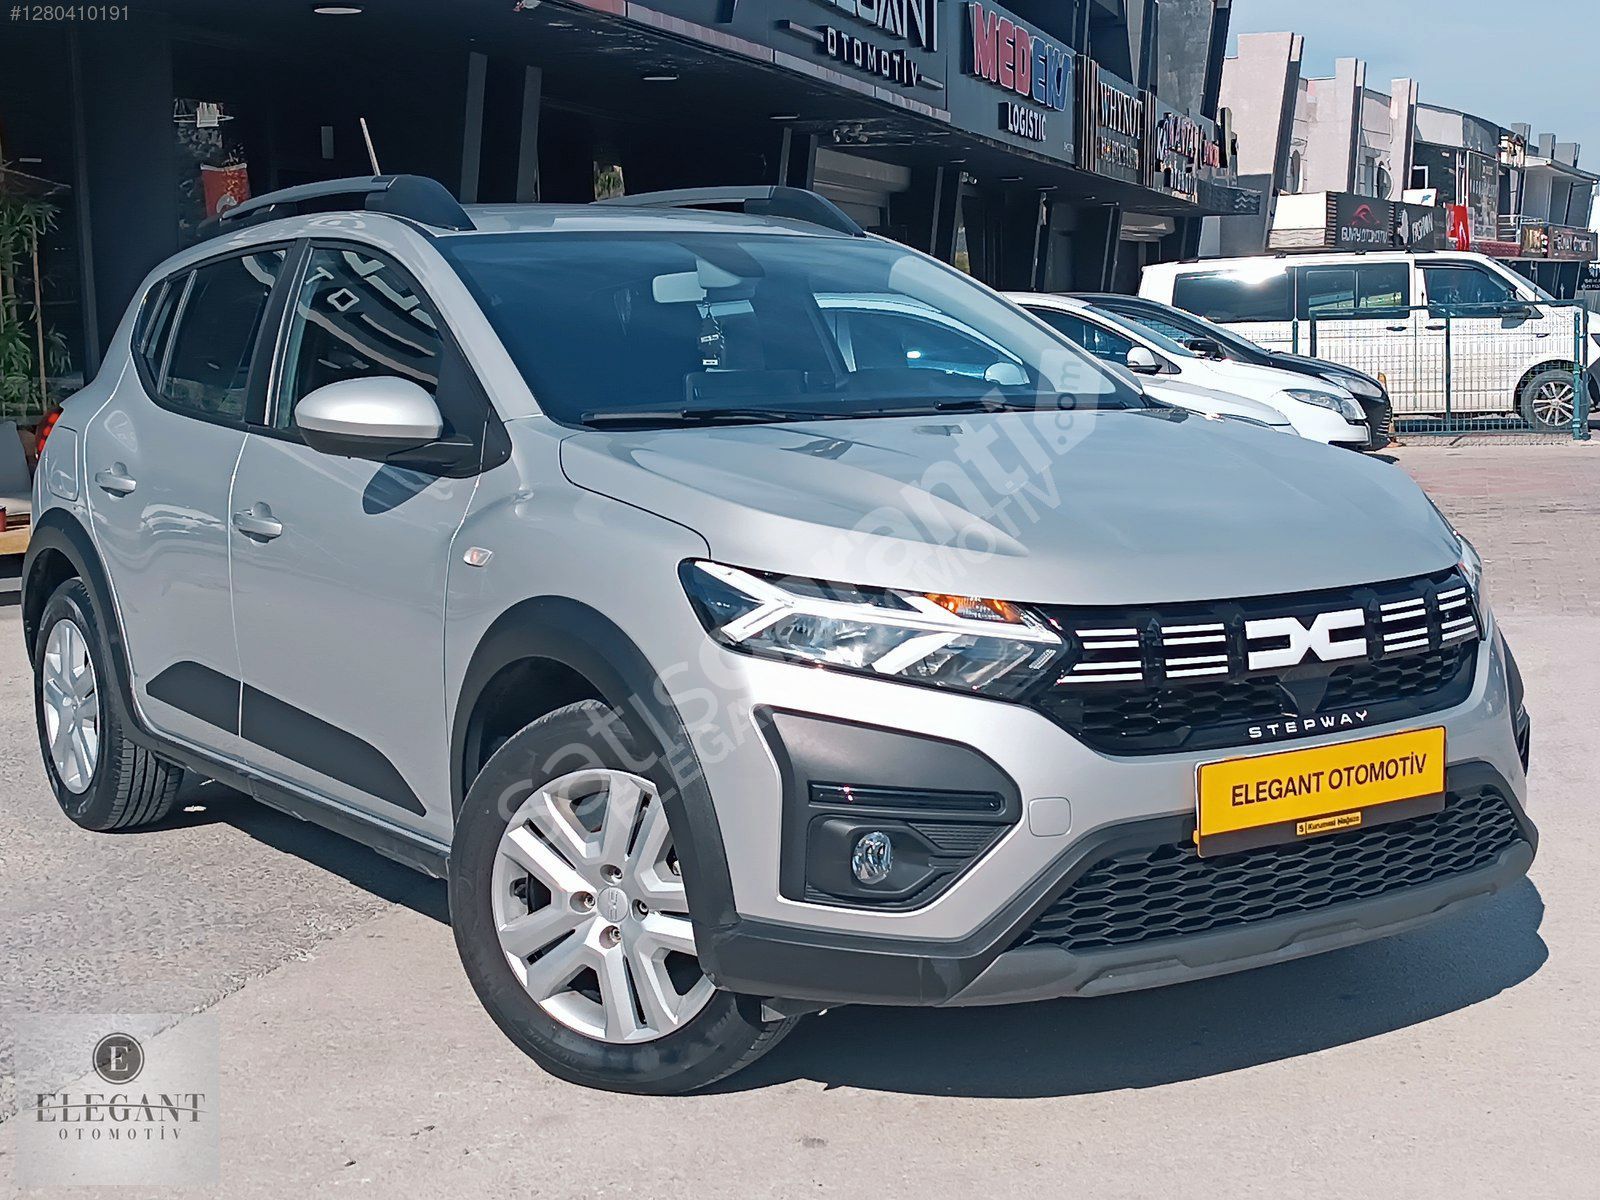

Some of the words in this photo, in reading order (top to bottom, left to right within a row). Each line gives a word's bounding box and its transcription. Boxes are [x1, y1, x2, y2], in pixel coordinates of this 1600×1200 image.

[1008, 101, 1047, 141] LOGISTIC
[1248, 710, 1368, 739] STEPWAY
[1231, 771, 1324, 807] ELEGANT
[1328, 751, 1427, 787] OTOMOTİV
